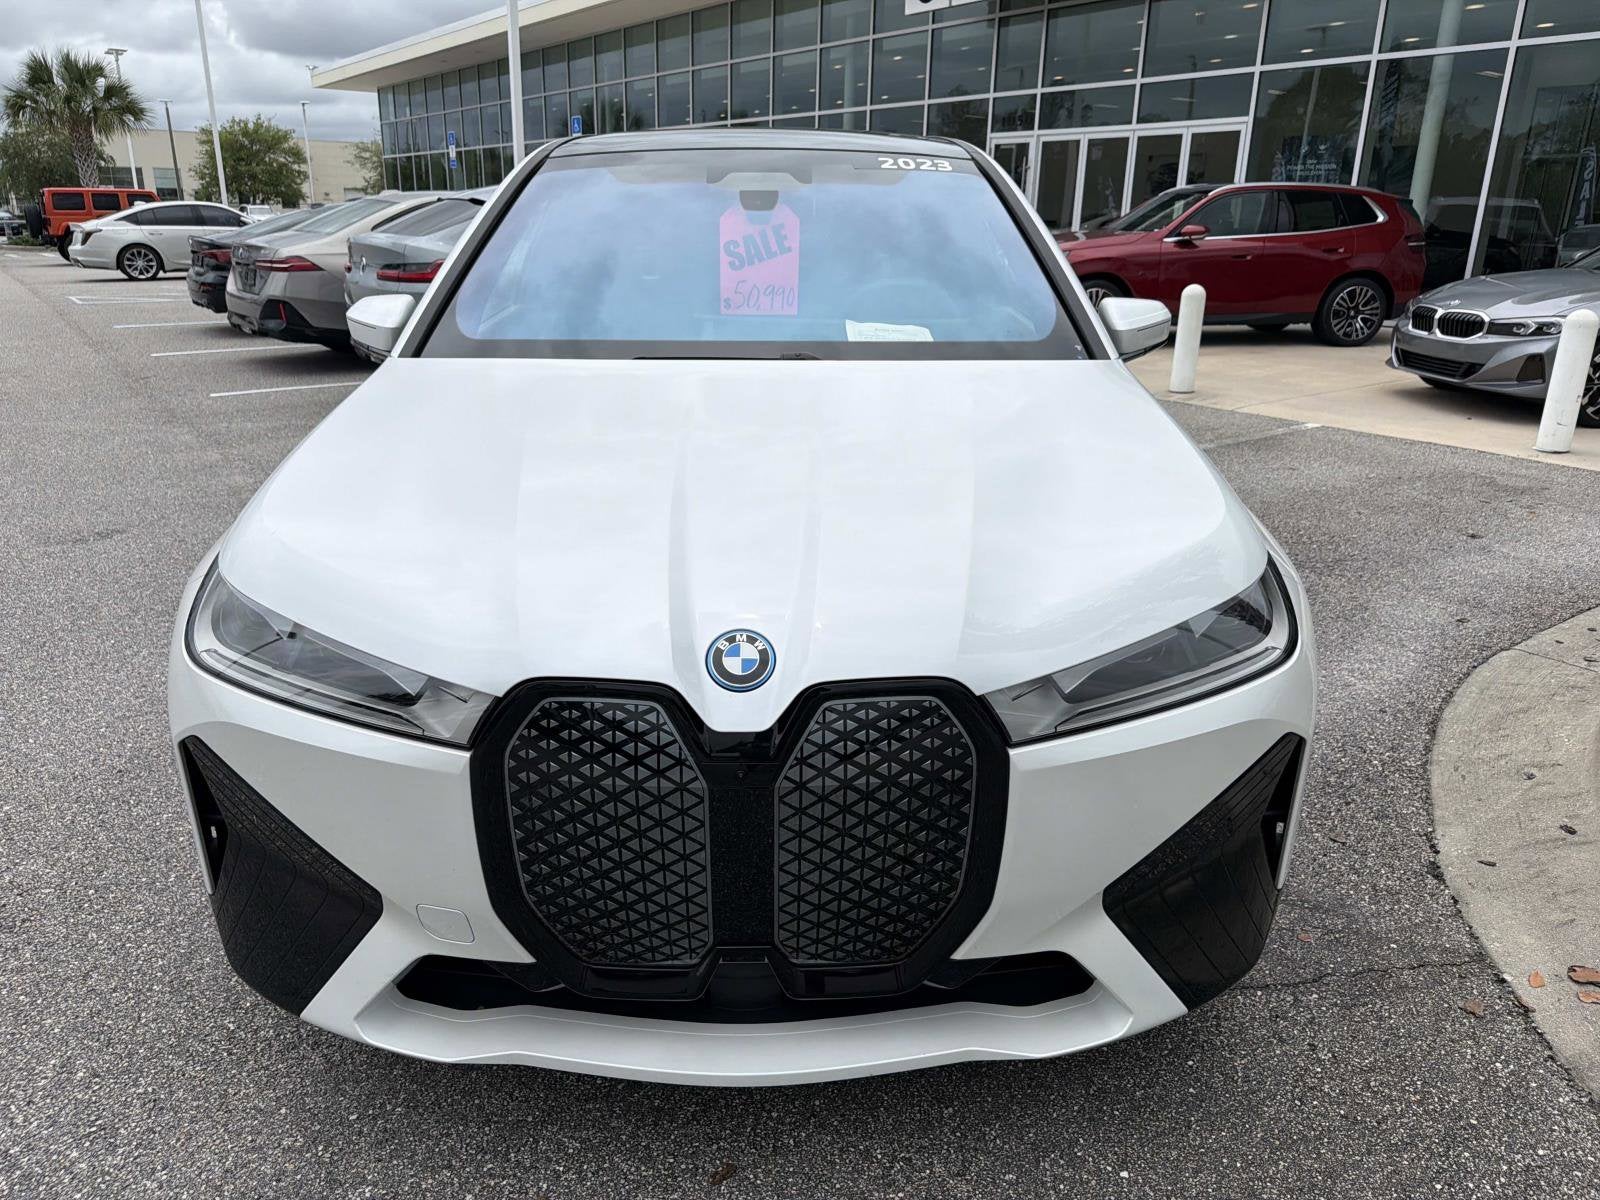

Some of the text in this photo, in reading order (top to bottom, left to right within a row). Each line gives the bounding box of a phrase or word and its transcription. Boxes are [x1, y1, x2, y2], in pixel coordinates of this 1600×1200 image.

[877, 157, 953, 171] 2023
[723, 223, 793, 271] SALE
[717, 633, 767, 651] BMW
